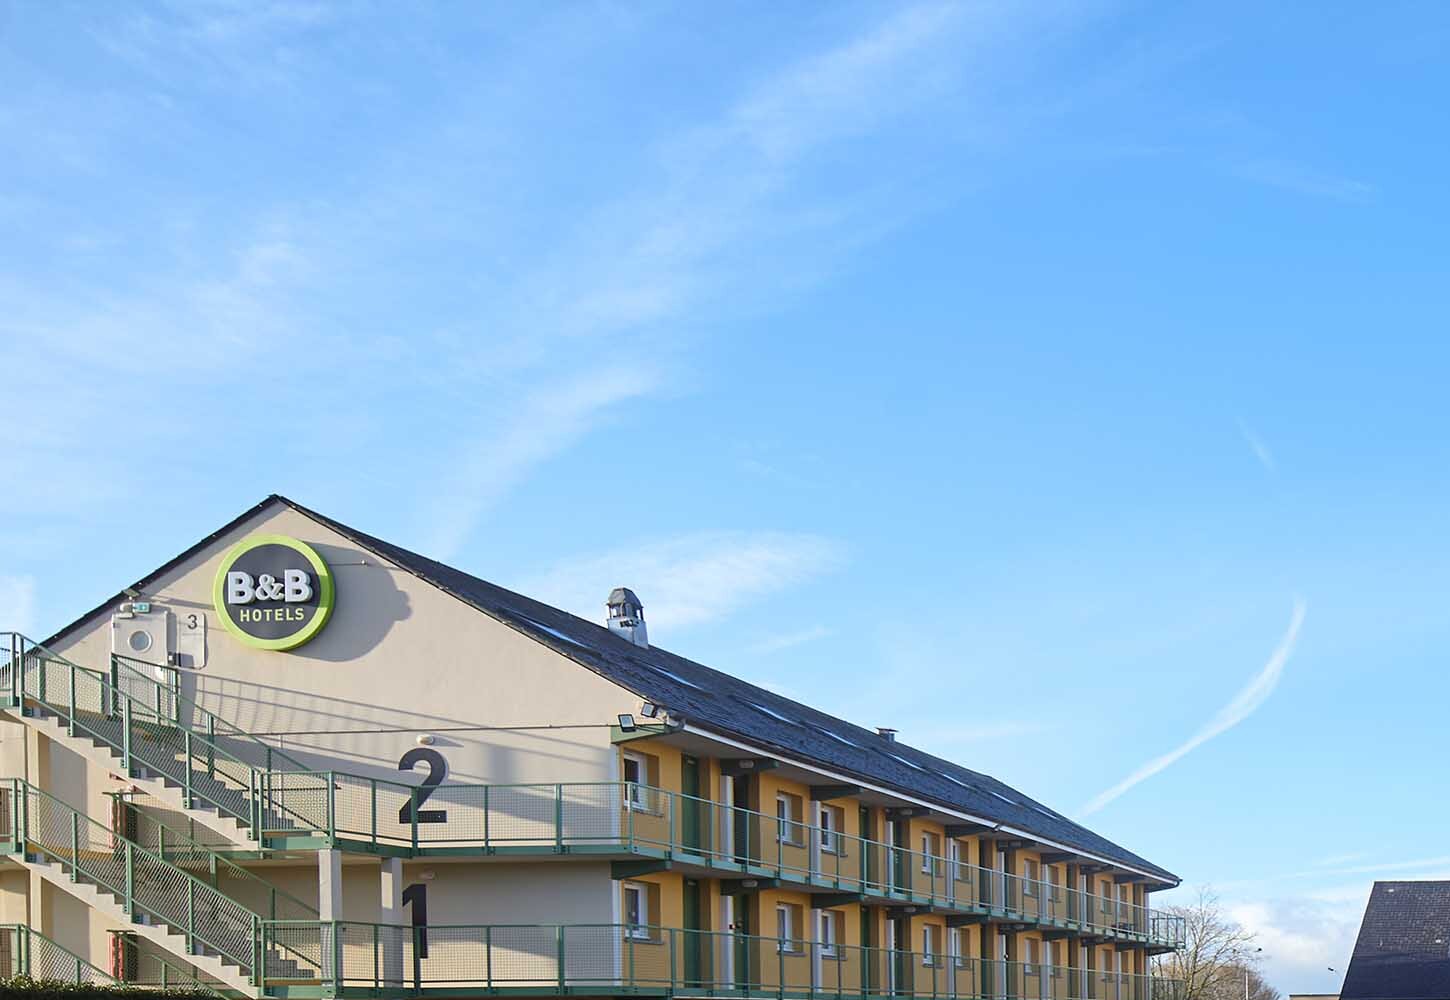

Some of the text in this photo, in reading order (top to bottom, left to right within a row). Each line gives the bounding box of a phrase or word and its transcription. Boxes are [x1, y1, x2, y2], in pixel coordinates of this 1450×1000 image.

[227, 568, 313, 604] B&B
[187, 614, 198, 630] 3
[239, 607, 305, 622] HOTELS
[398, 747, 447, 824] 2
[402, 883, 429, 959] 1
